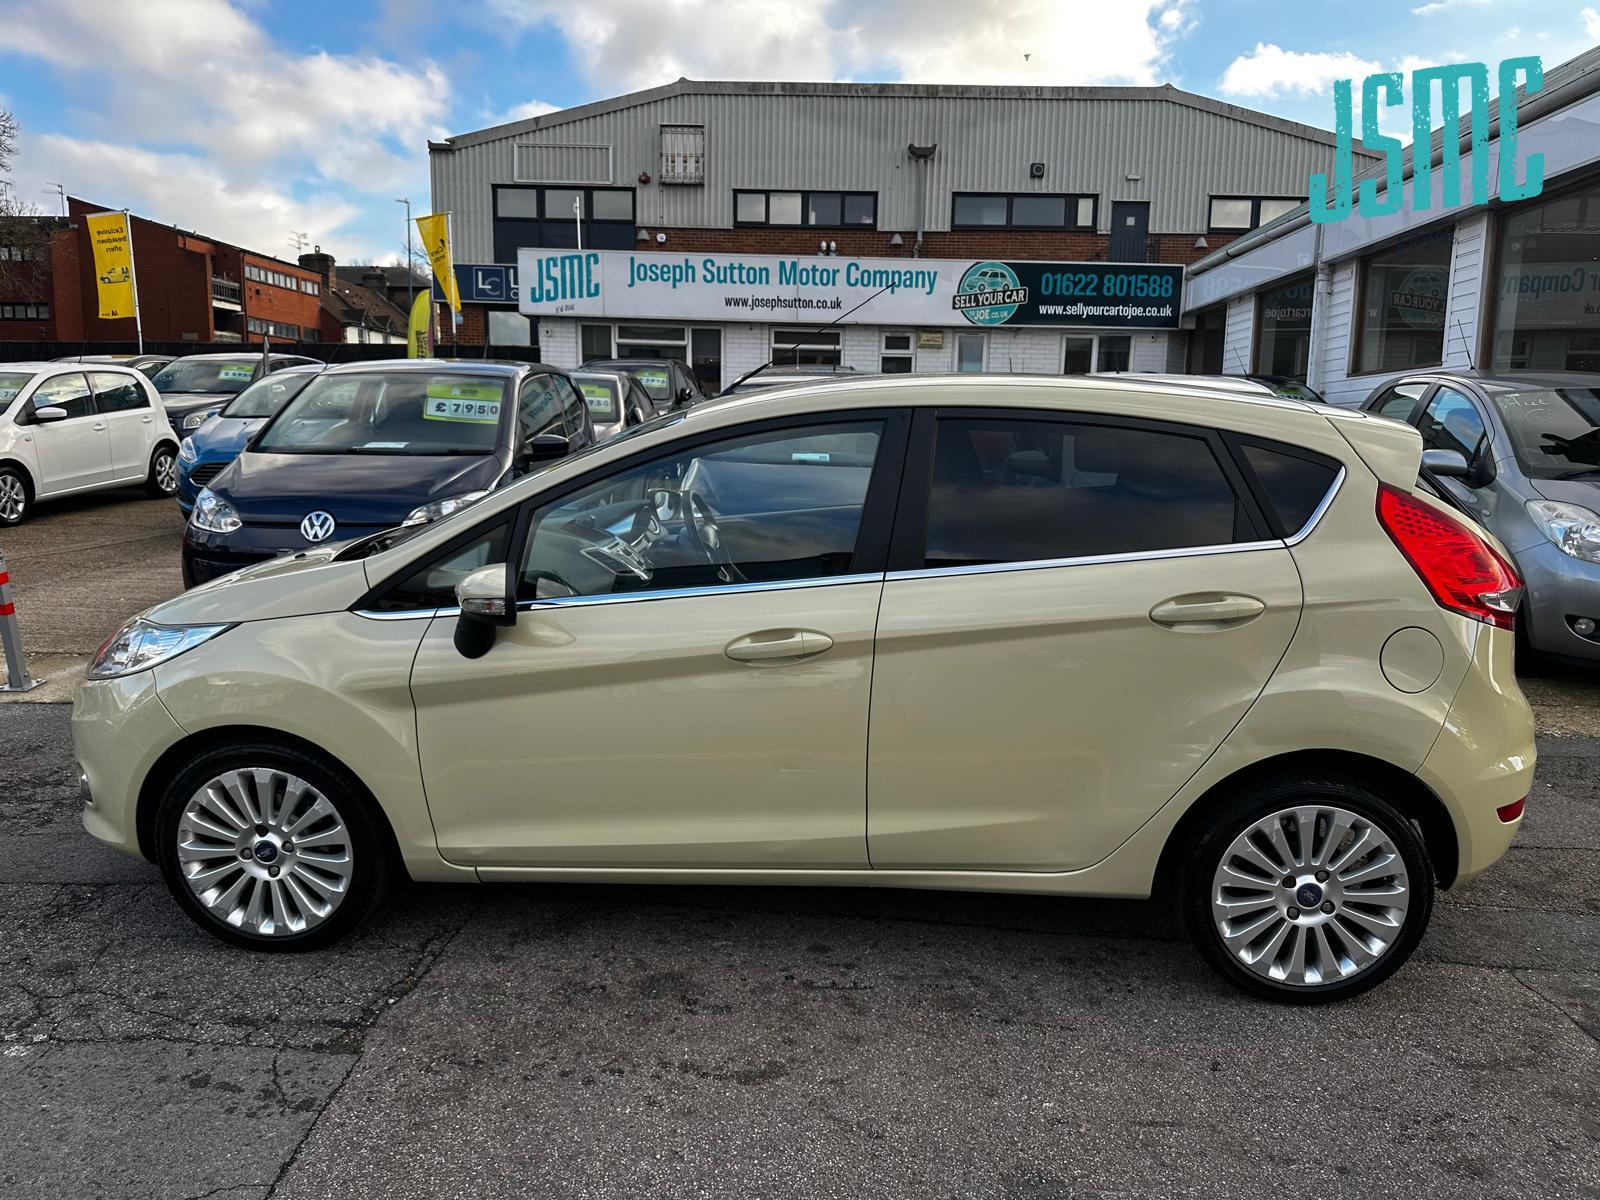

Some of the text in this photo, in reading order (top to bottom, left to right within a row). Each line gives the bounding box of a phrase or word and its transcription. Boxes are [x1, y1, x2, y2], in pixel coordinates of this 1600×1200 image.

[530, 253, 600, 303] JSMC
[628, 256, 938, 295] Joseph Sutton Motor Company
[1040, 272, 1098, 297] 01622
[1102, 274, 1174, 298] 801588
[724, 295, 842, 311] www.josephsutton.co.uk
[954, 290, 1025, 308] SELL YOUR CAR
[974, 309, 990, 320] JOE
[1038, 302, 1173, 319] www.sellyourcartojoe.co.uk
